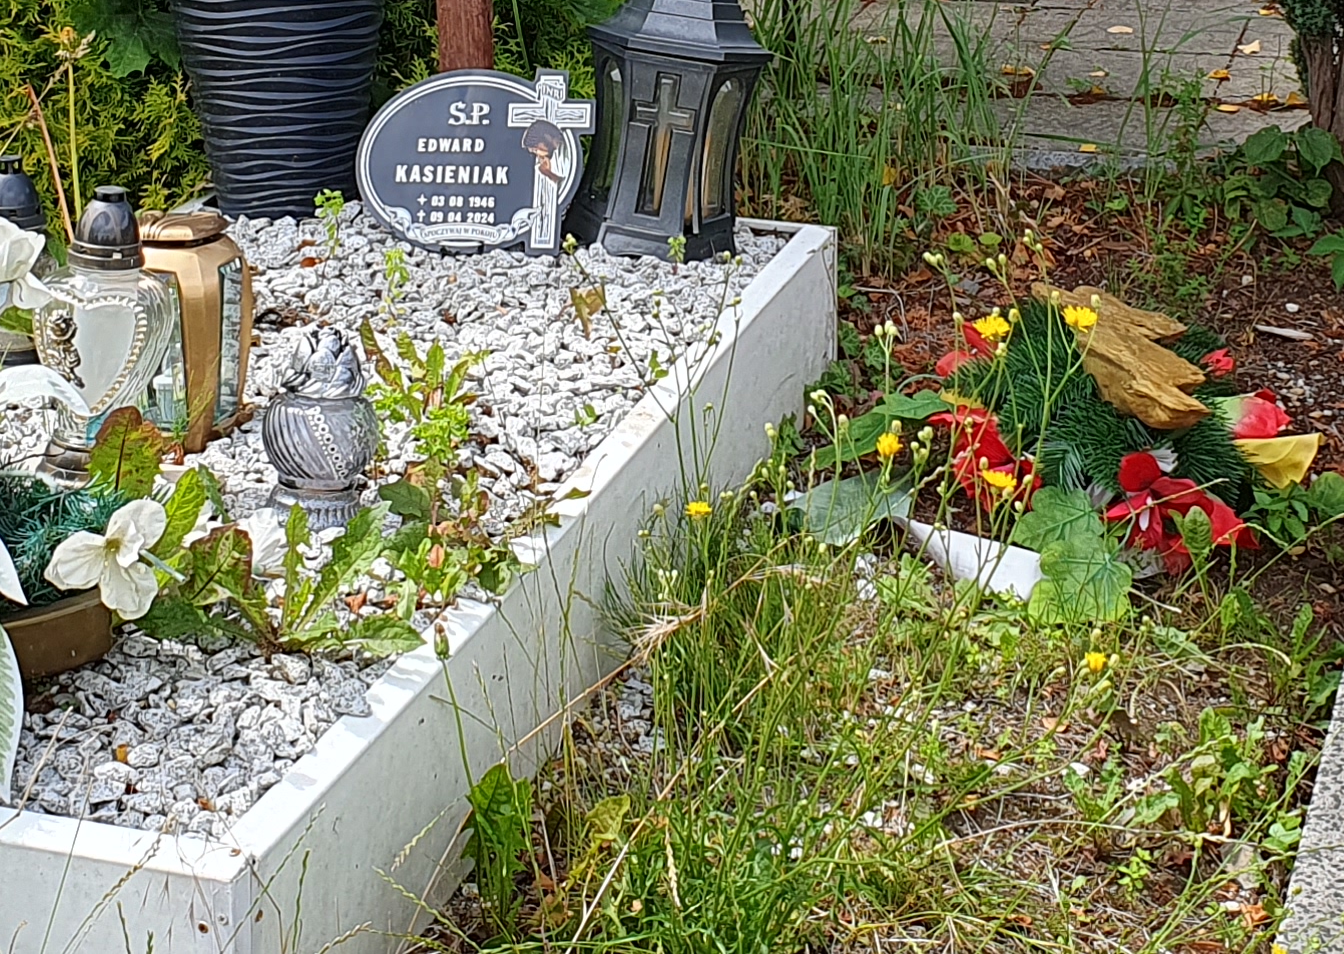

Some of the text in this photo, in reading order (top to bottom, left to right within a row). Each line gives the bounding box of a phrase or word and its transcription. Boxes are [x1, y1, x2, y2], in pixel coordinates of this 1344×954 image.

[417, 138, 485, 153] EDWARD
[395, 165, 509, 185] KASIENIAK
[431, 195, 495, 208] 03 08 1946
[430, 211, 495, 224] 09 04 2024
